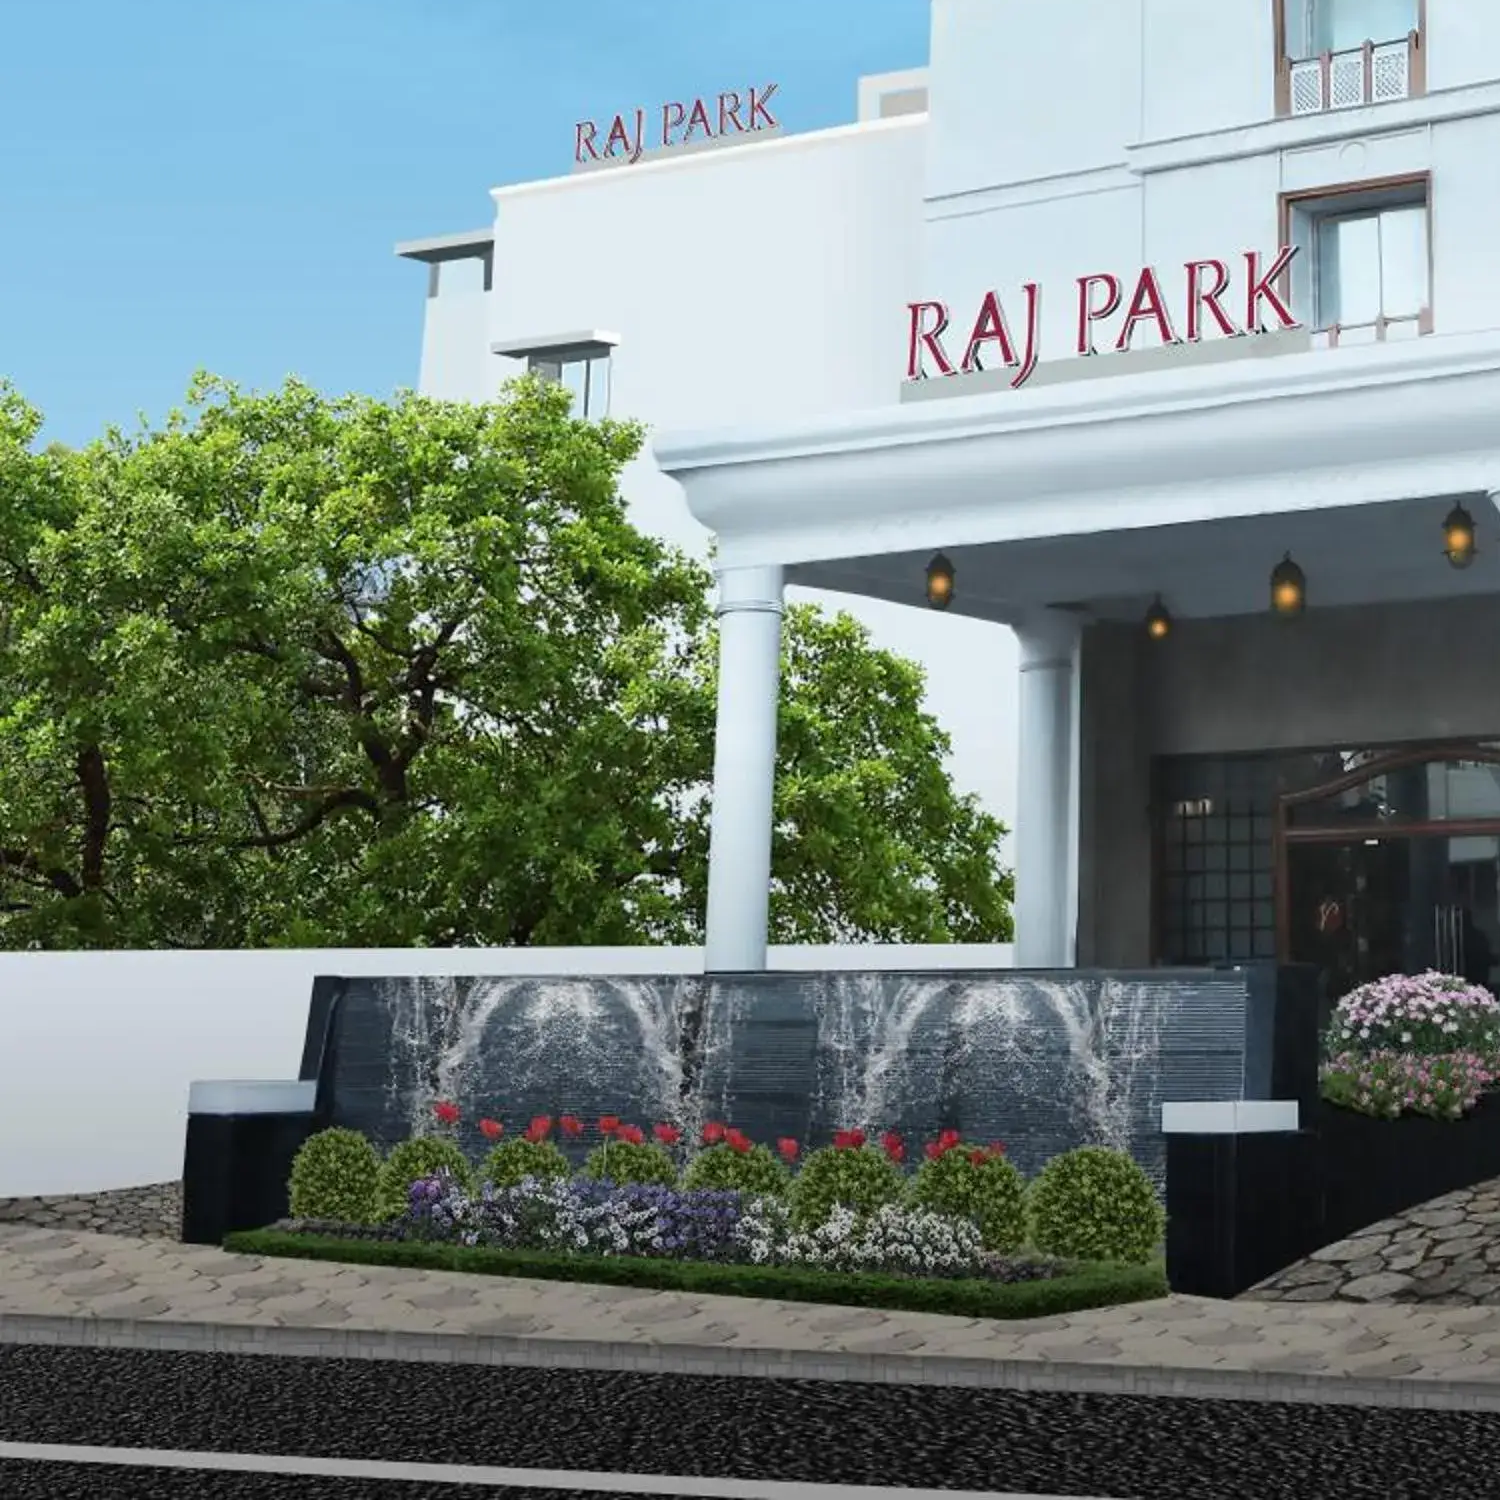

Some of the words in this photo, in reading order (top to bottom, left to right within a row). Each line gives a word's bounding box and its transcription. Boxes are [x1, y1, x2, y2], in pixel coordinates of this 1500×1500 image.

[575, 108, 643, 164] RAJ
[662, 83, 779, 146] PARK
[907, 282, 1041, 389] RAJ
[1076, 245, 1300, 356] PARK
